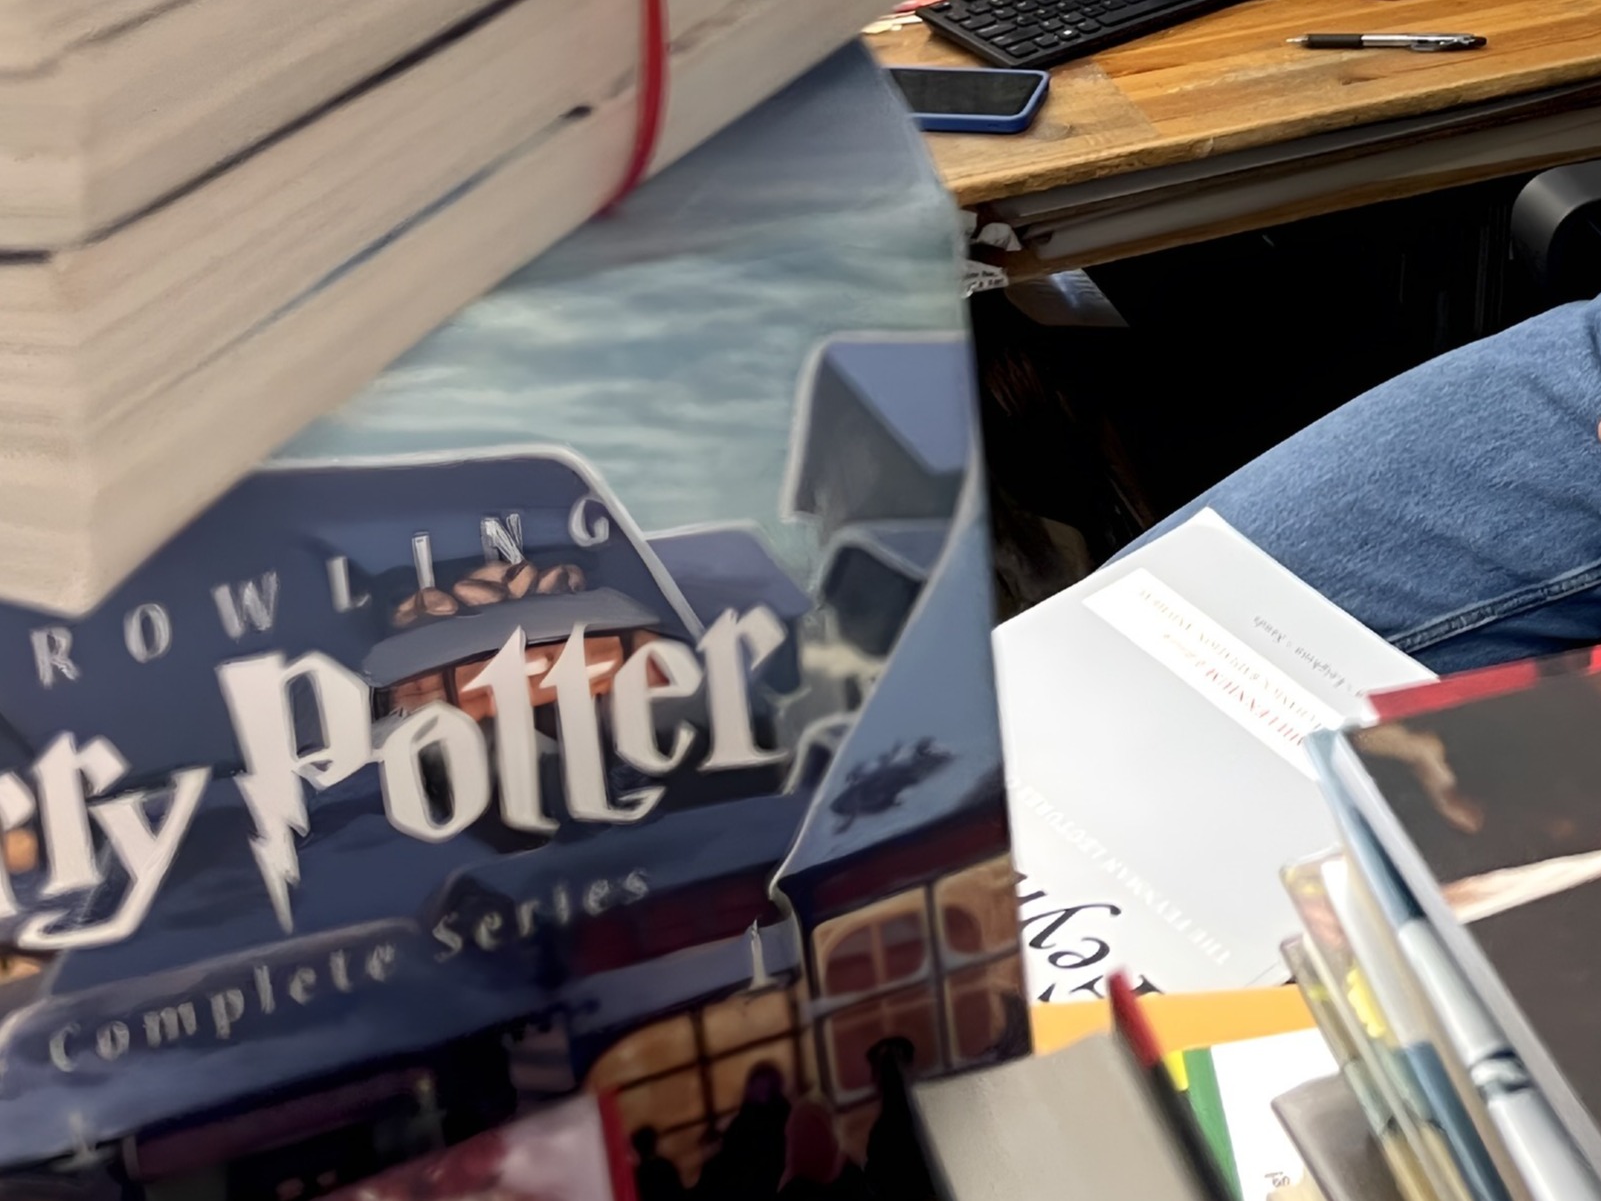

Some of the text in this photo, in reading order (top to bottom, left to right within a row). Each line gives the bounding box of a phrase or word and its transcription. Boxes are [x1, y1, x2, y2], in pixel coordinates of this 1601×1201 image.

[28, 493, 613, 689] ROWLING
[214, 602, 792, 935] Potter
[48, 866, 653, 1074] Complete Series
